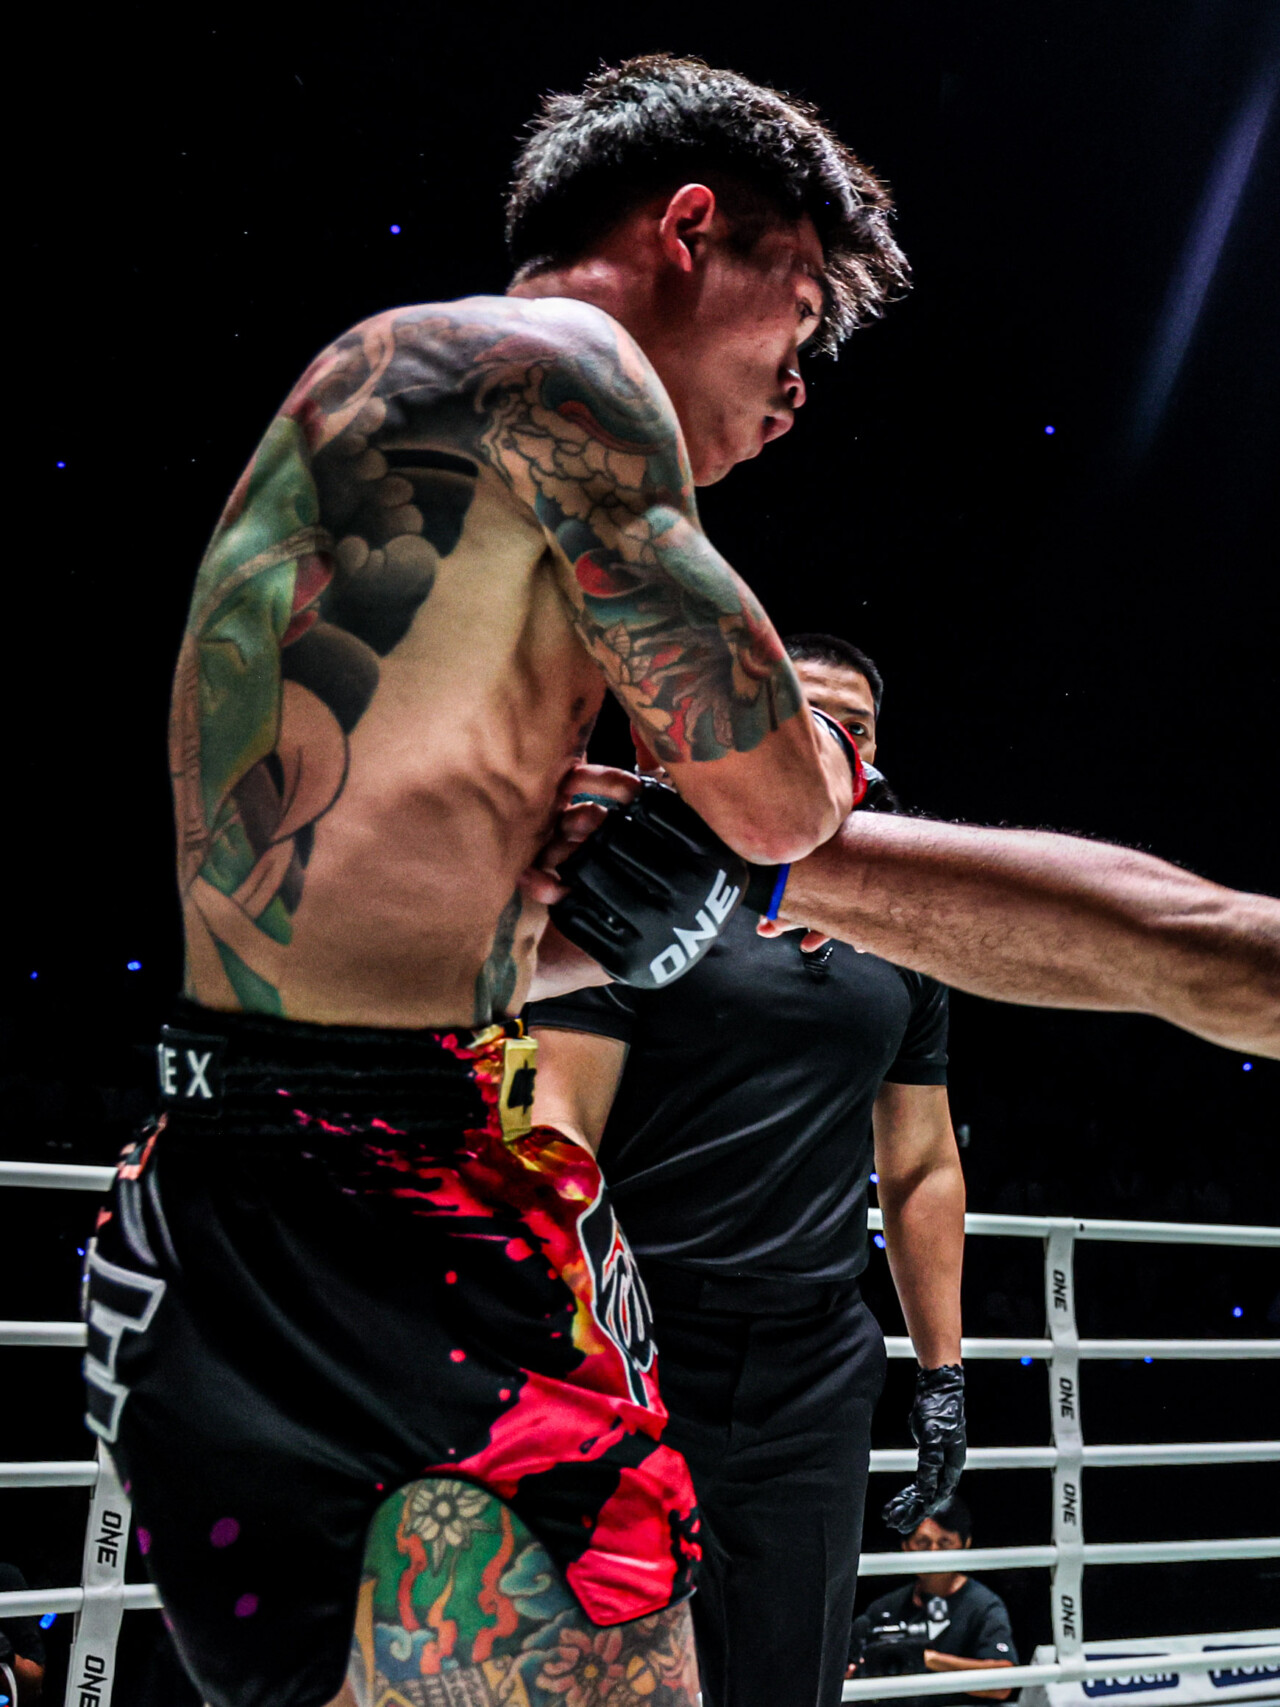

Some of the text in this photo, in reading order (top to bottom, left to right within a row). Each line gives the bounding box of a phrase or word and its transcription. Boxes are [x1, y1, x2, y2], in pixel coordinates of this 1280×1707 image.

[649, 869, 740, 985] ONE
[1052, 1269, 1068, 1313] ONE
[1058, 1377, 1075, 1421] ONE
[1061, 1482, 1078, 1526] ONE
[95, 1510, 124, 1568] ONE
[1061, 1594, 1077, 1641] ONE
